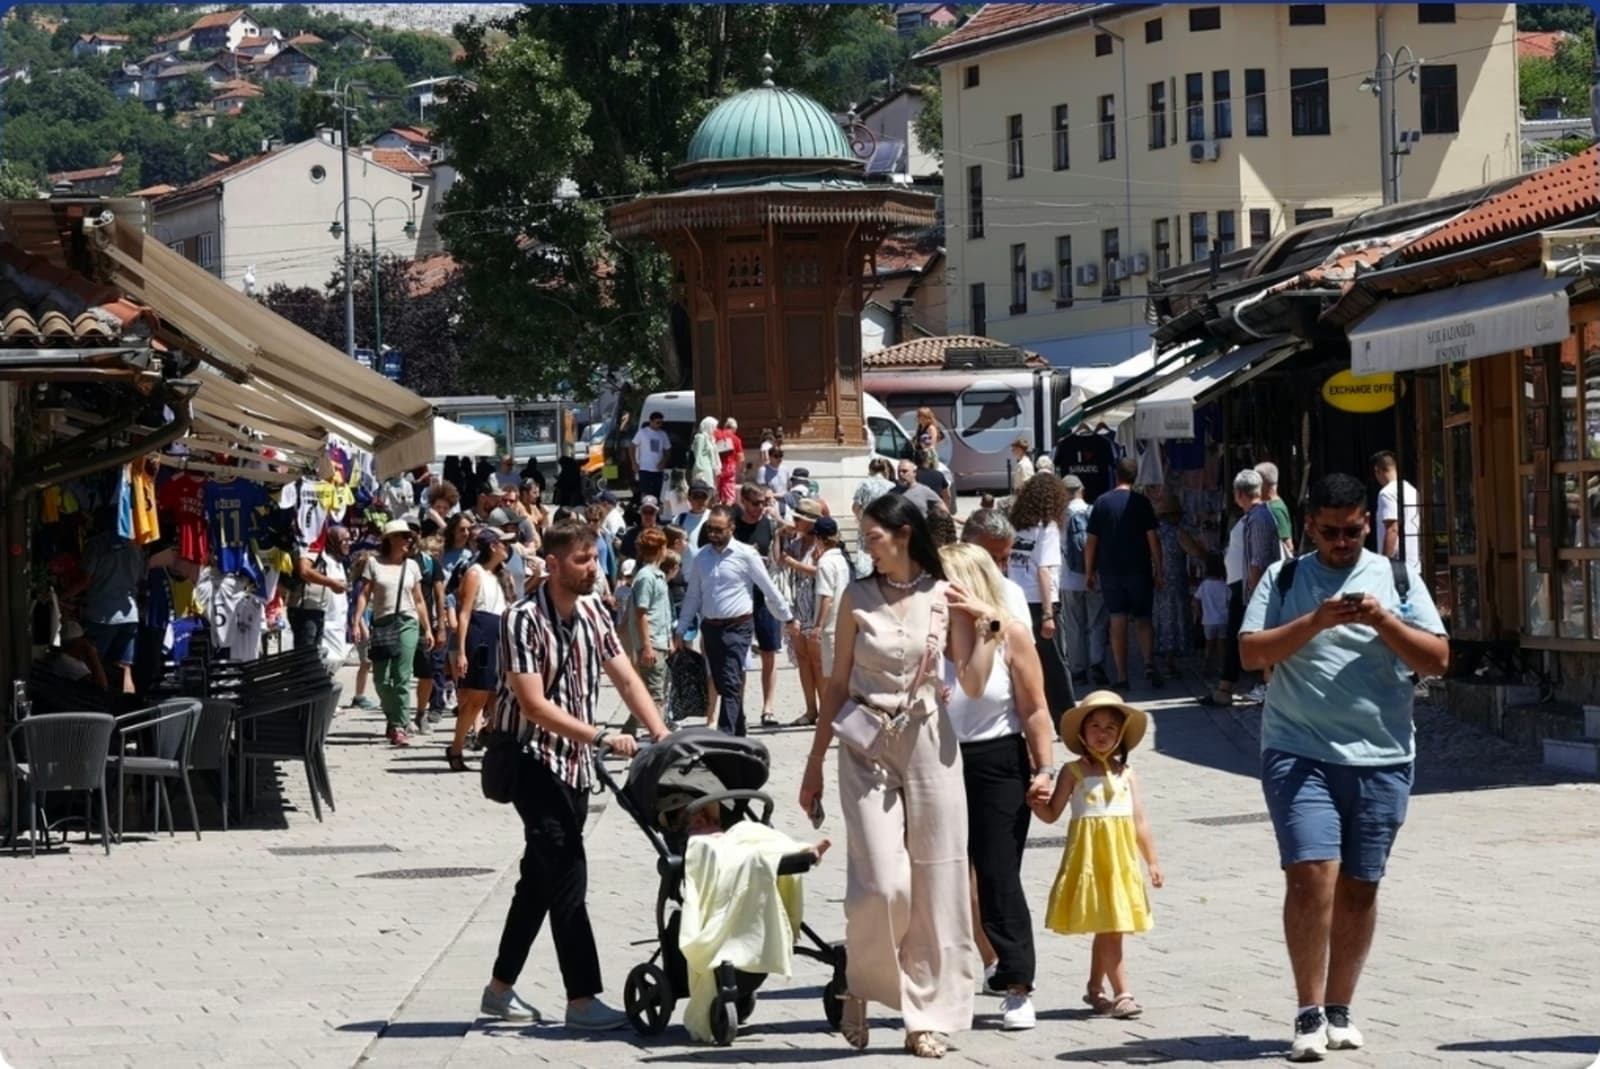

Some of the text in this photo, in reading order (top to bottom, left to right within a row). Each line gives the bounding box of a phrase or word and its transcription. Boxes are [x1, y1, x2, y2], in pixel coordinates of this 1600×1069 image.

[1329, 383, 1396, 395] EXCHANGE OFFIC
[216, 510, 242, 548] 11
